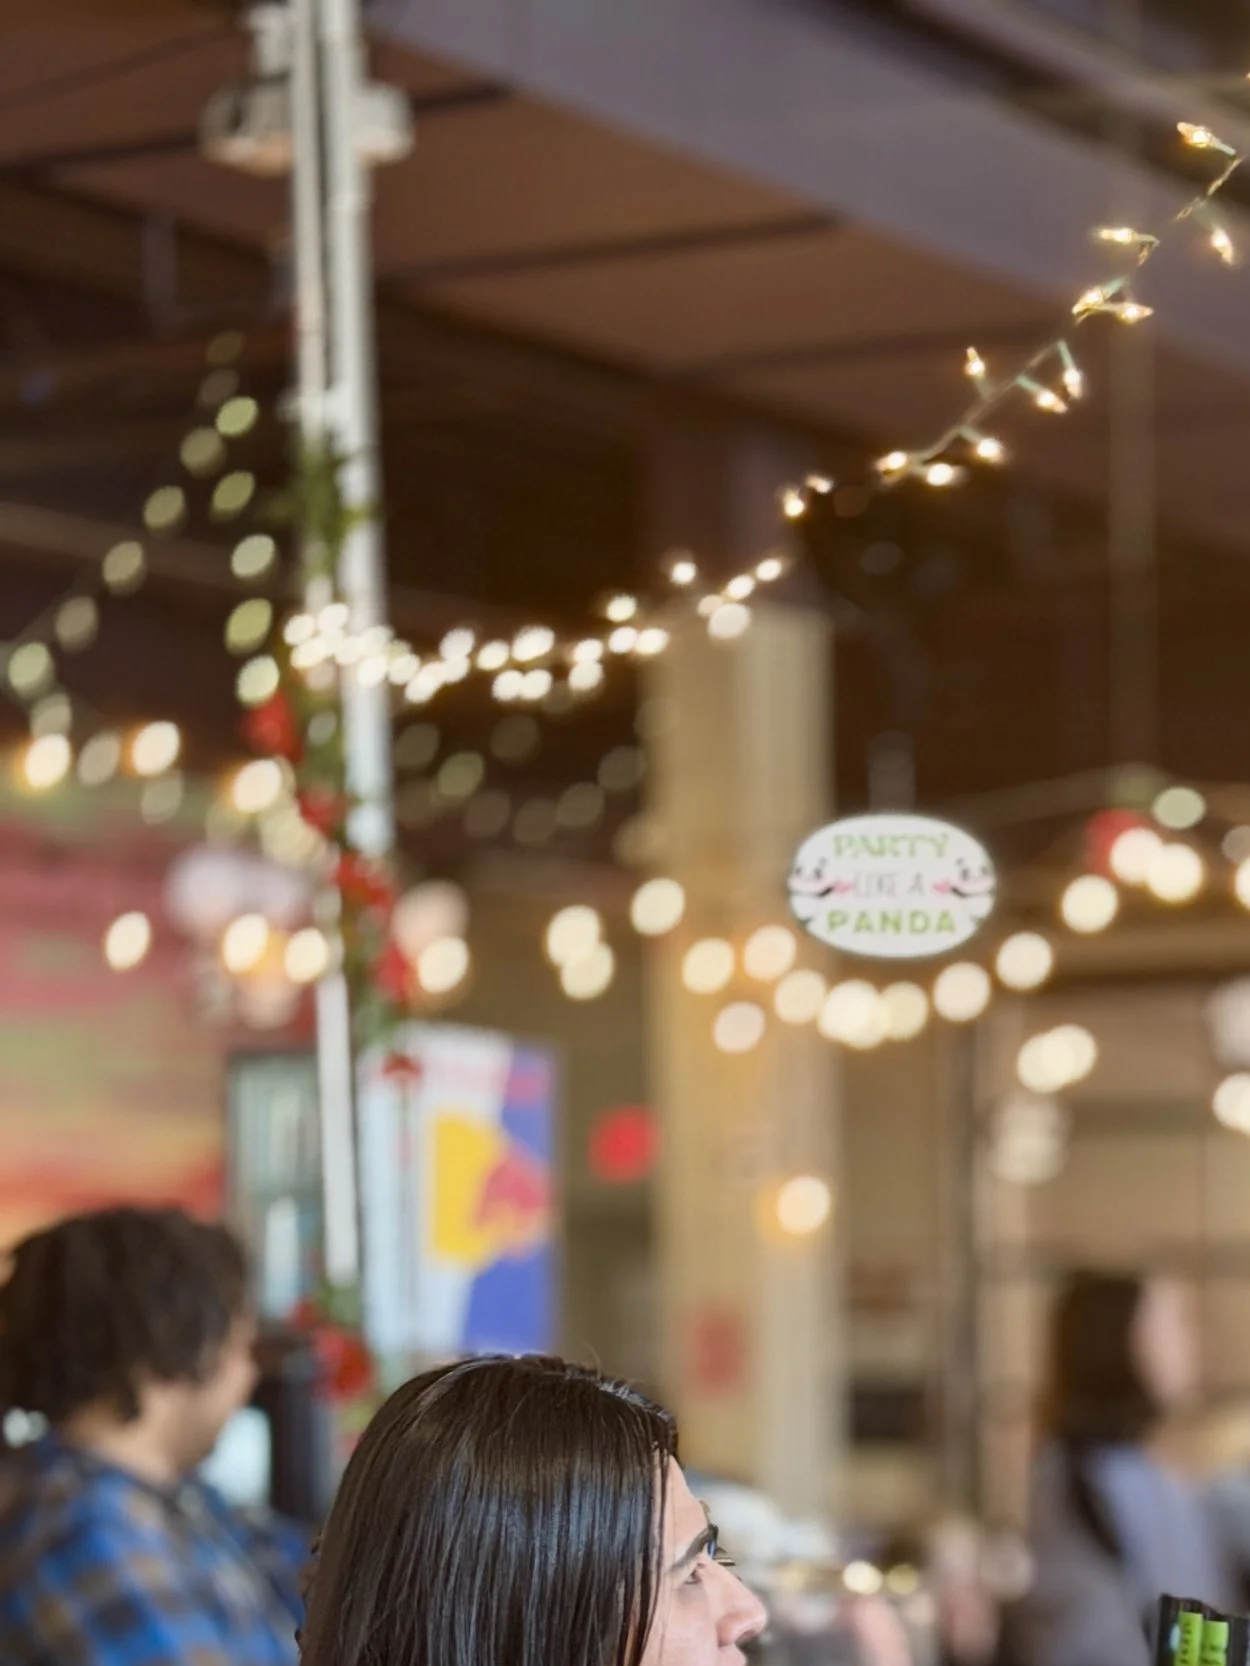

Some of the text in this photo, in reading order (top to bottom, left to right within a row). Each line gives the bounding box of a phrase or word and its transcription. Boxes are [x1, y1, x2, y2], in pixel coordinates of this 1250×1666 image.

[834, 834, 949, 858] PARTY
[909, 872, 925, 897] A
[827, 910, 956, 934] PANDA
